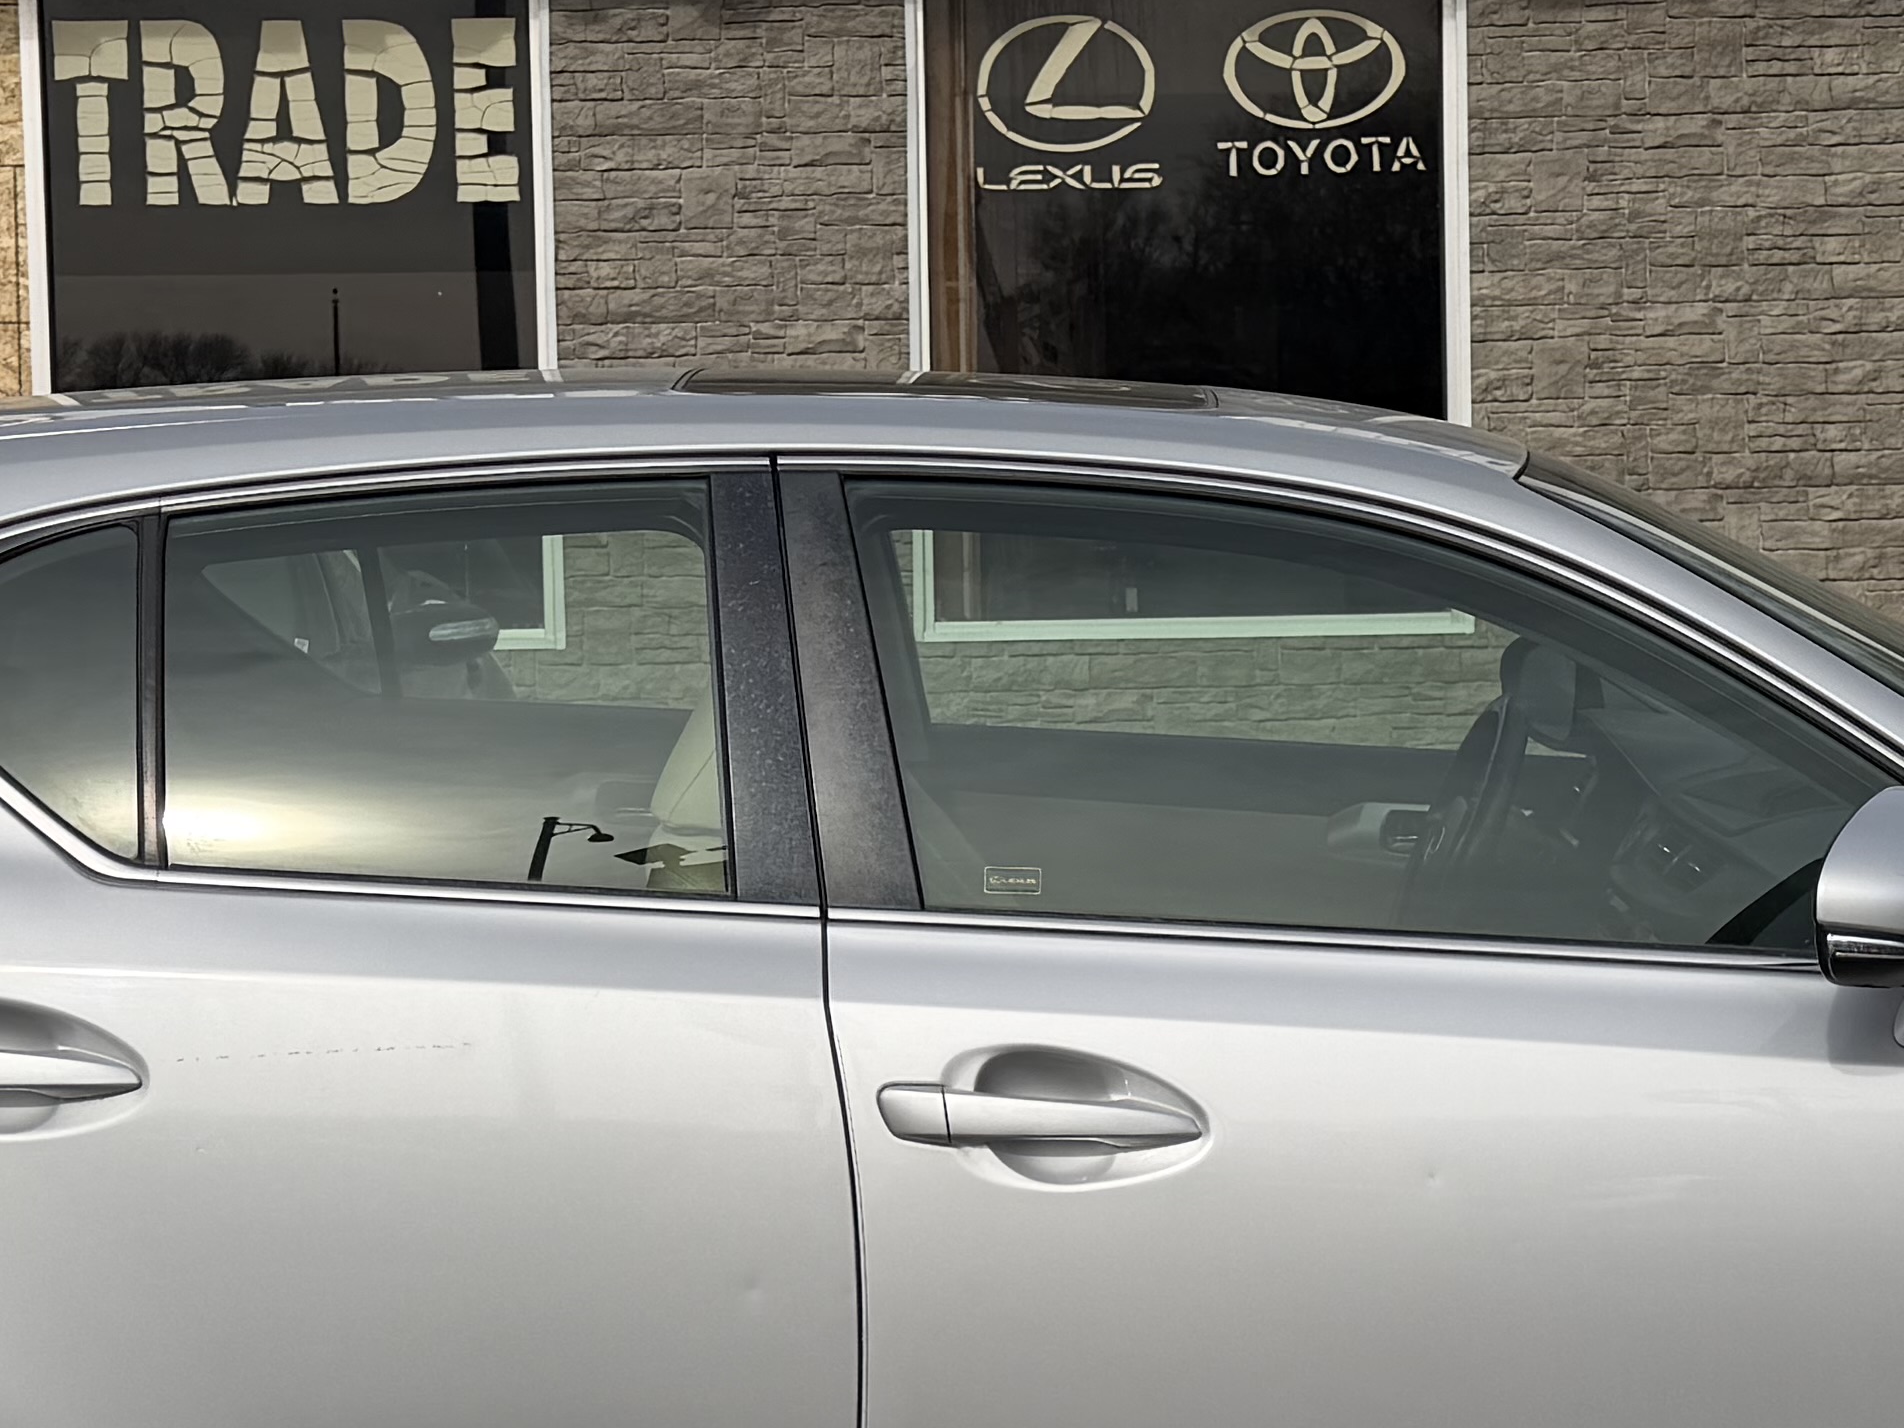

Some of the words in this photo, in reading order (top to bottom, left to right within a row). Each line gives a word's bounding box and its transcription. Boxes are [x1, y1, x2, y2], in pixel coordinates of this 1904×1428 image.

[51, 17, 521, 206] TRADE
[976, 163, 1163, 190] LEXUS
[1216, 136, 1427, 177] TOYOTA
